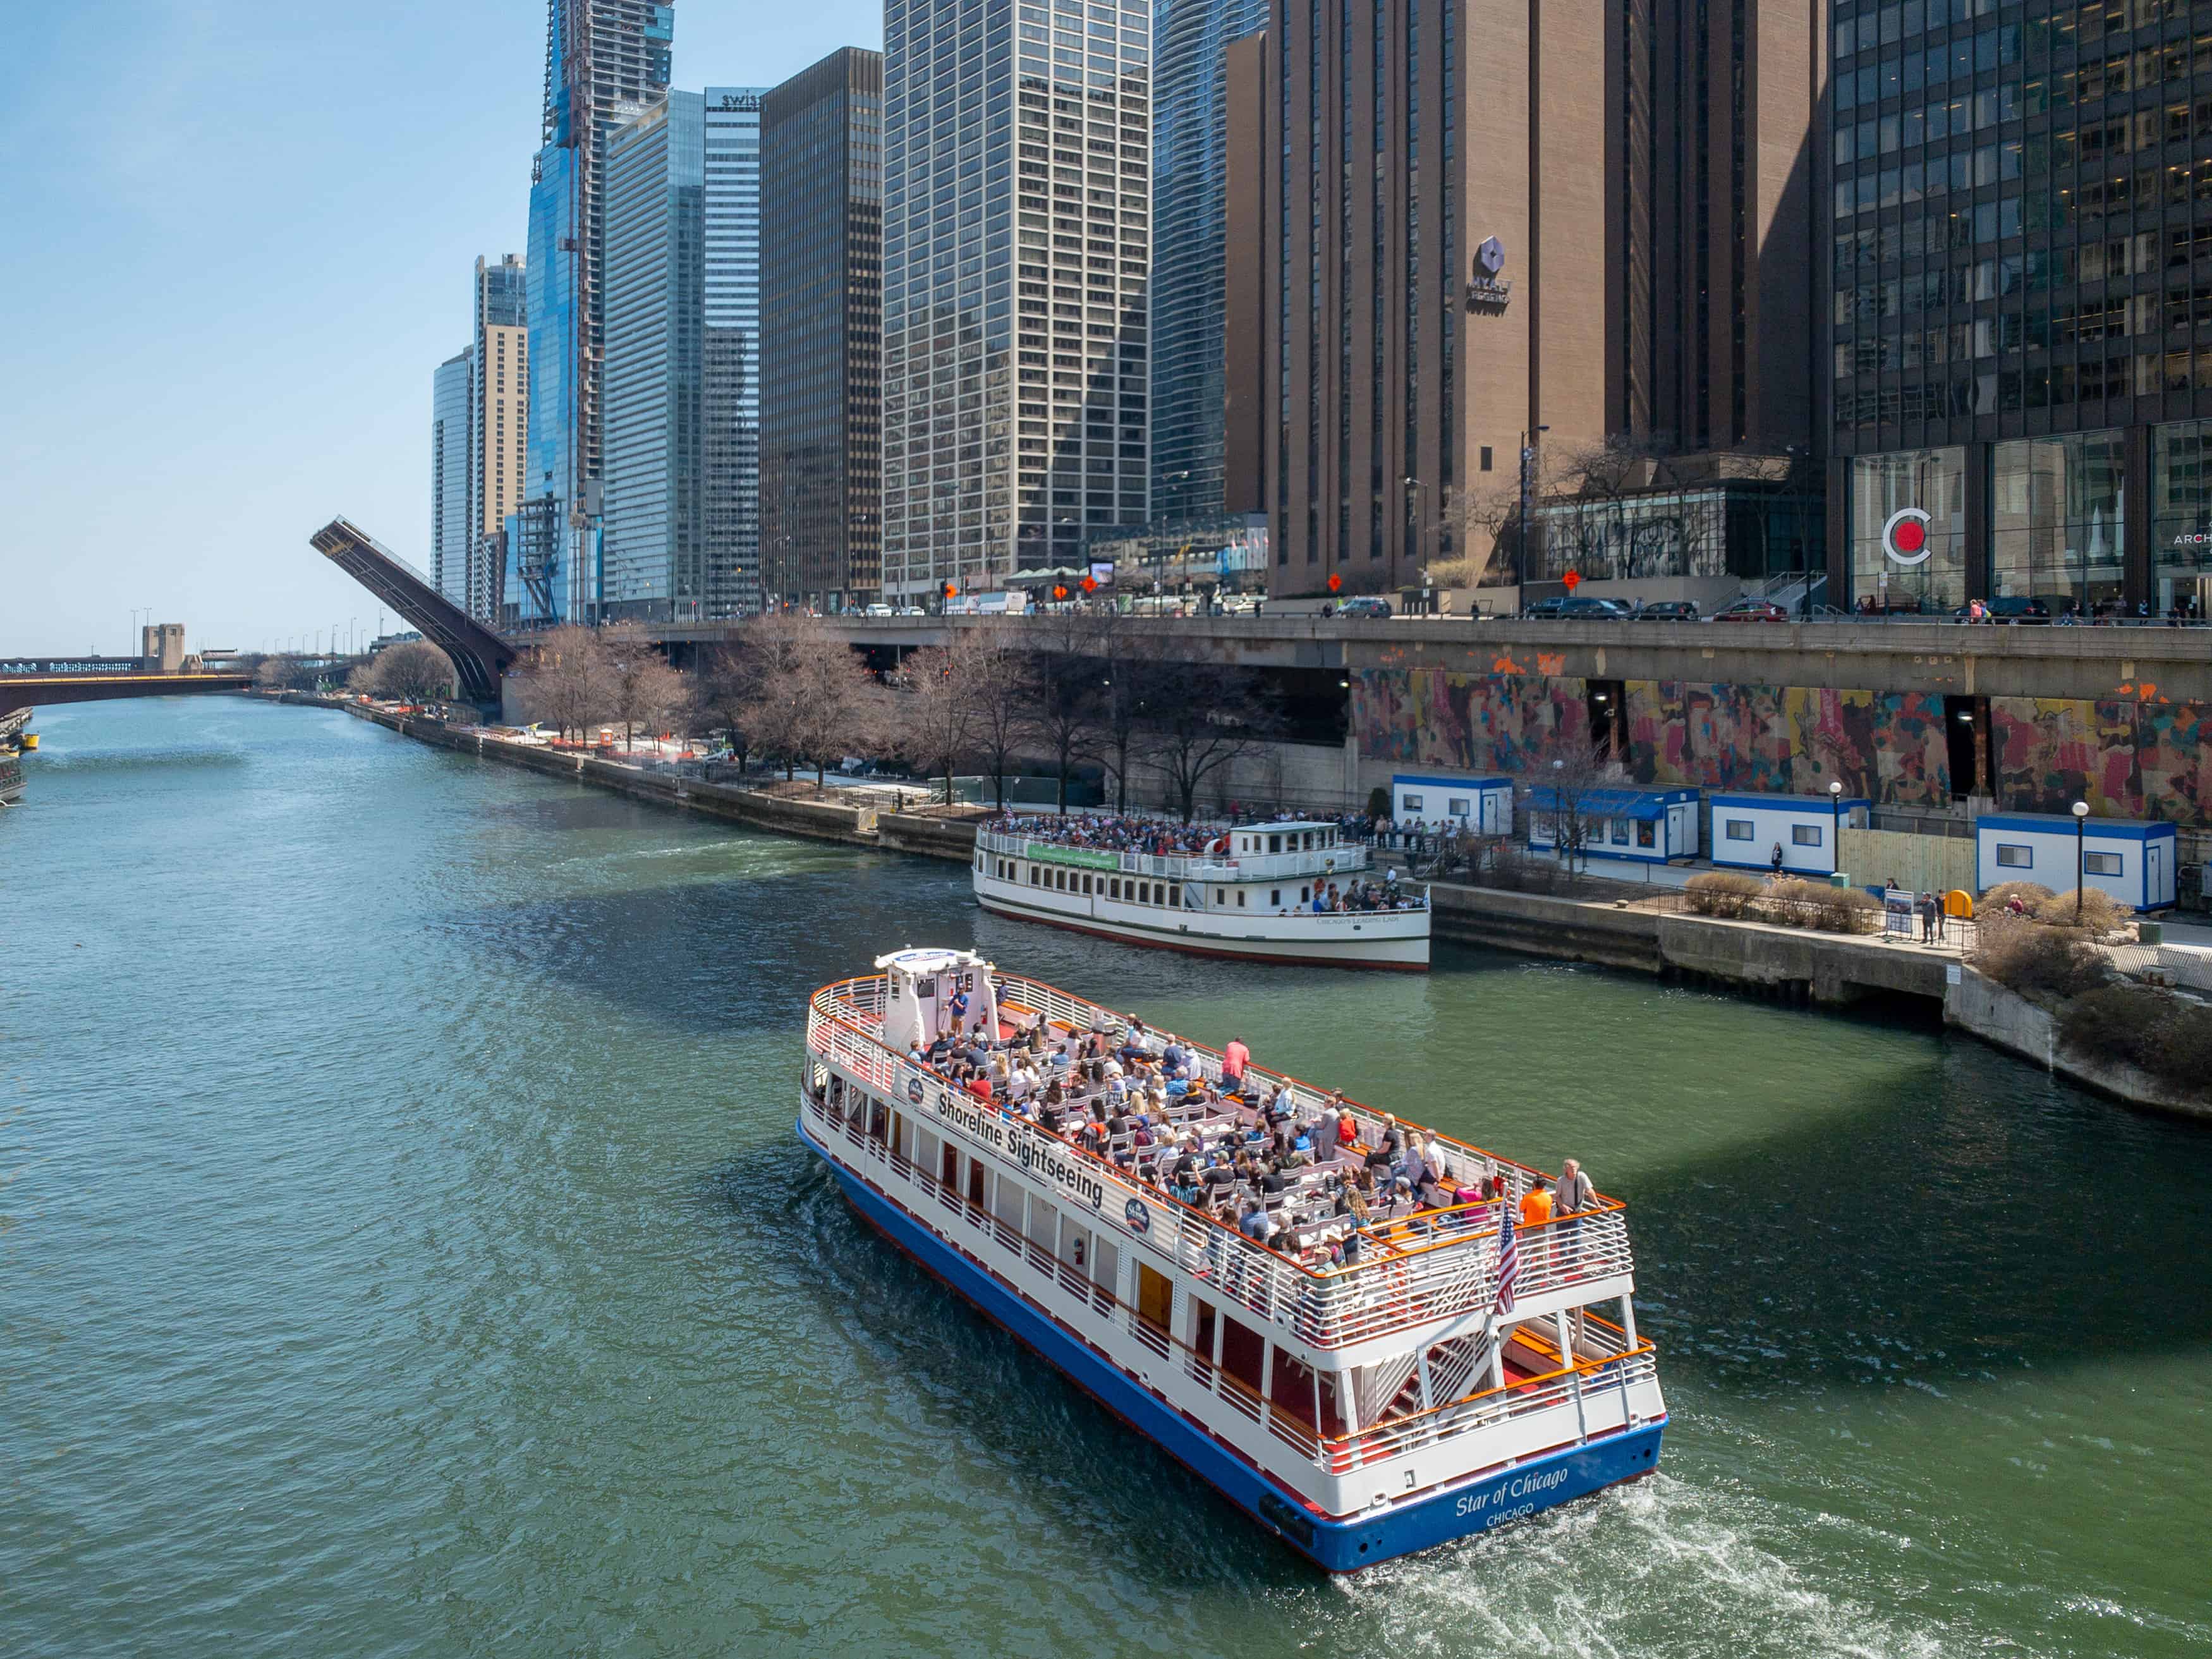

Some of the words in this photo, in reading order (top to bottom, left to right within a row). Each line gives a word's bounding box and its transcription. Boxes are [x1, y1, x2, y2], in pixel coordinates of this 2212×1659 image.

[722, 90, 760, 106] swis
[1473, 276, 1516, 293] HYATT
[939, 1093, 1002, 1146] Shoreline
[1007, 1129, 1102, 1209] Sightseeing
[1456, 1493, 1490, 1517] Star
[1493, 1482, 1508, 1506] of
[1510, 1468, 1567, 1497] Chicago
[1486, 1503, 1534, 1526] CHICAGO
